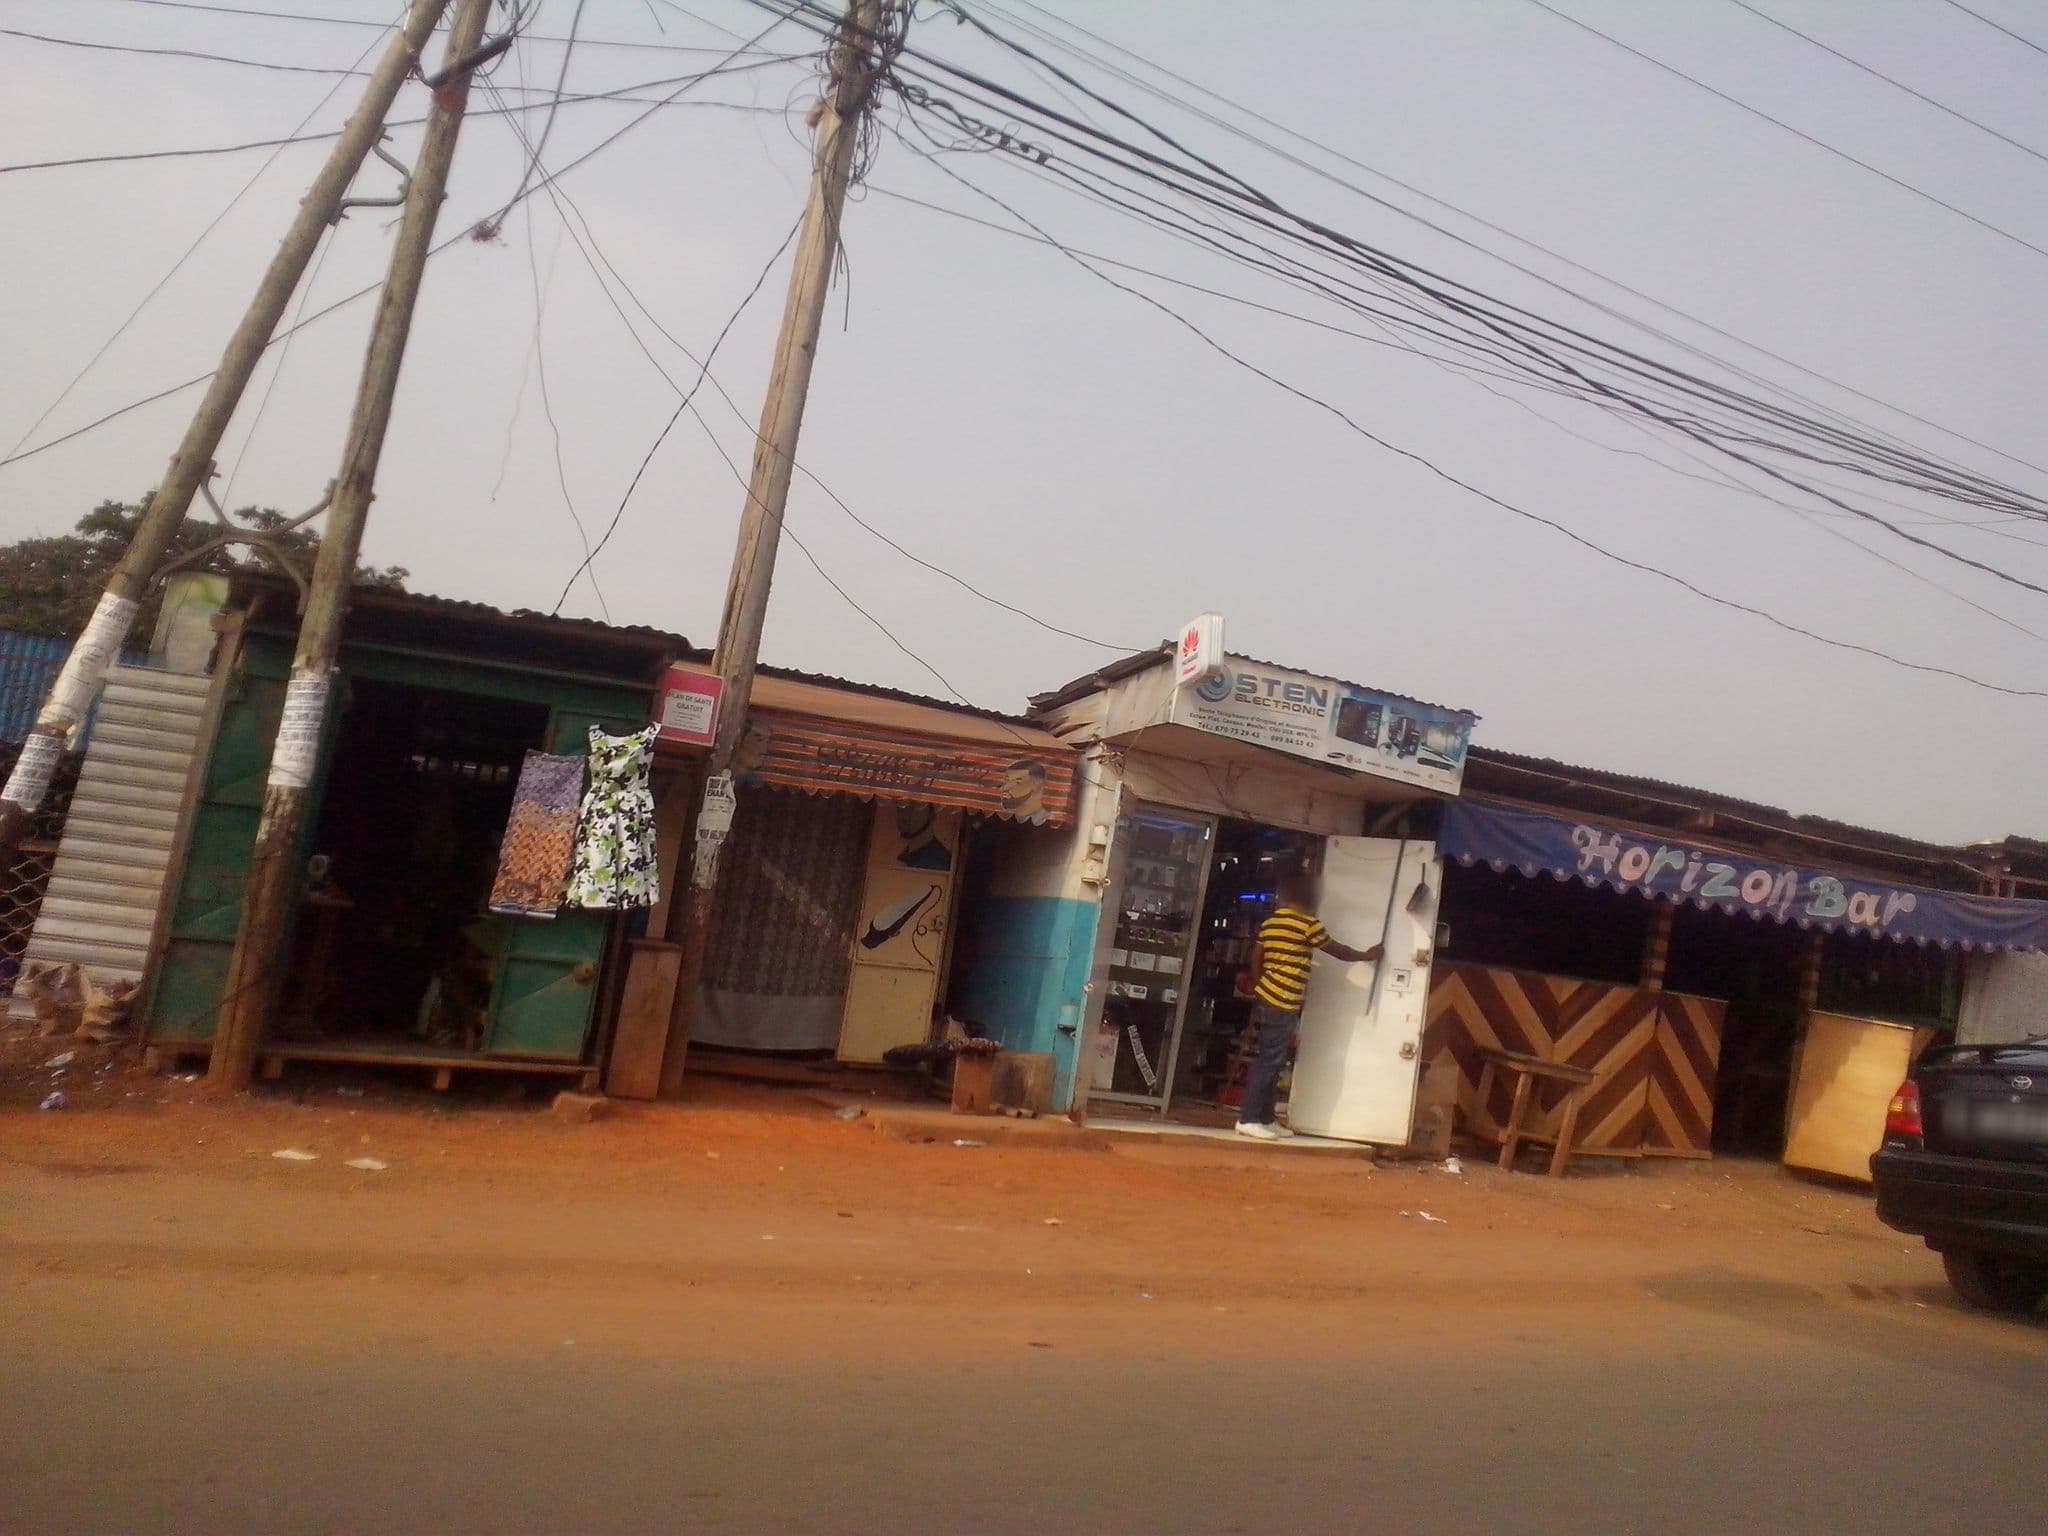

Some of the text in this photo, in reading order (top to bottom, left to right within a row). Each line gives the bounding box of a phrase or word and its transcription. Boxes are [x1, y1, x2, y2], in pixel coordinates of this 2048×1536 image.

[1234, 693, 1325, 718] ELECTRONIC
[1235, 674, 1328, 707] STEN
[1572, 825, 1917, 927] Horizon Bar
